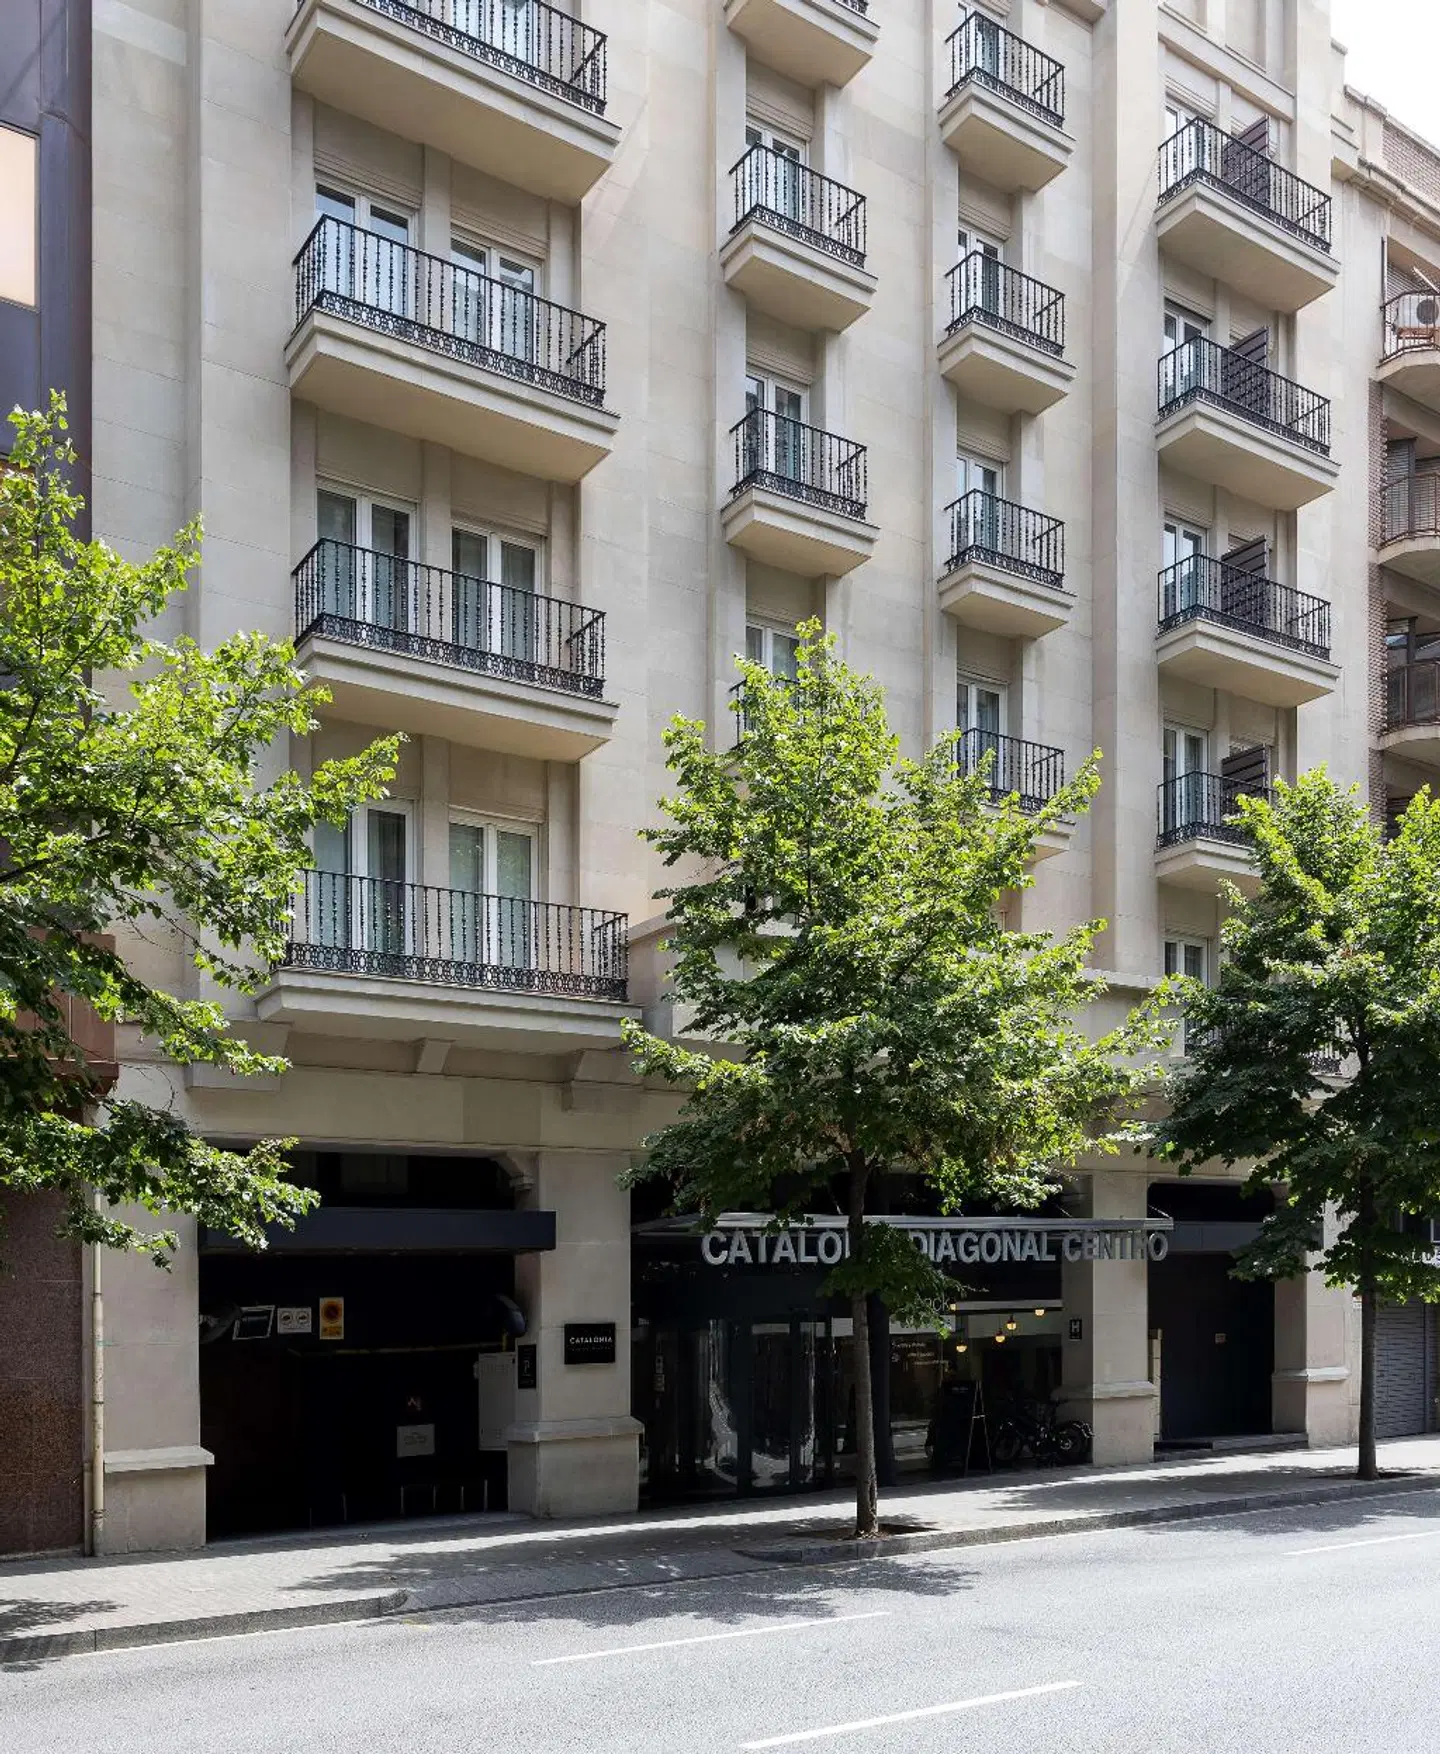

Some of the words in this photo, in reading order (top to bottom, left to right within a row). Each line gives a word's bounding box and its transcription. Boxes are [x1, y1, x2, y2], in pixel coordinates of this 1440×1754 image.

[701, 1229, 852, 1265] CATALO
[908, 1230, 1056, 1263] DIAGONAL
[1062, 1231, 1168, 1262] CENTRO
[568, 1335, 613, 1345] CATALONIA
